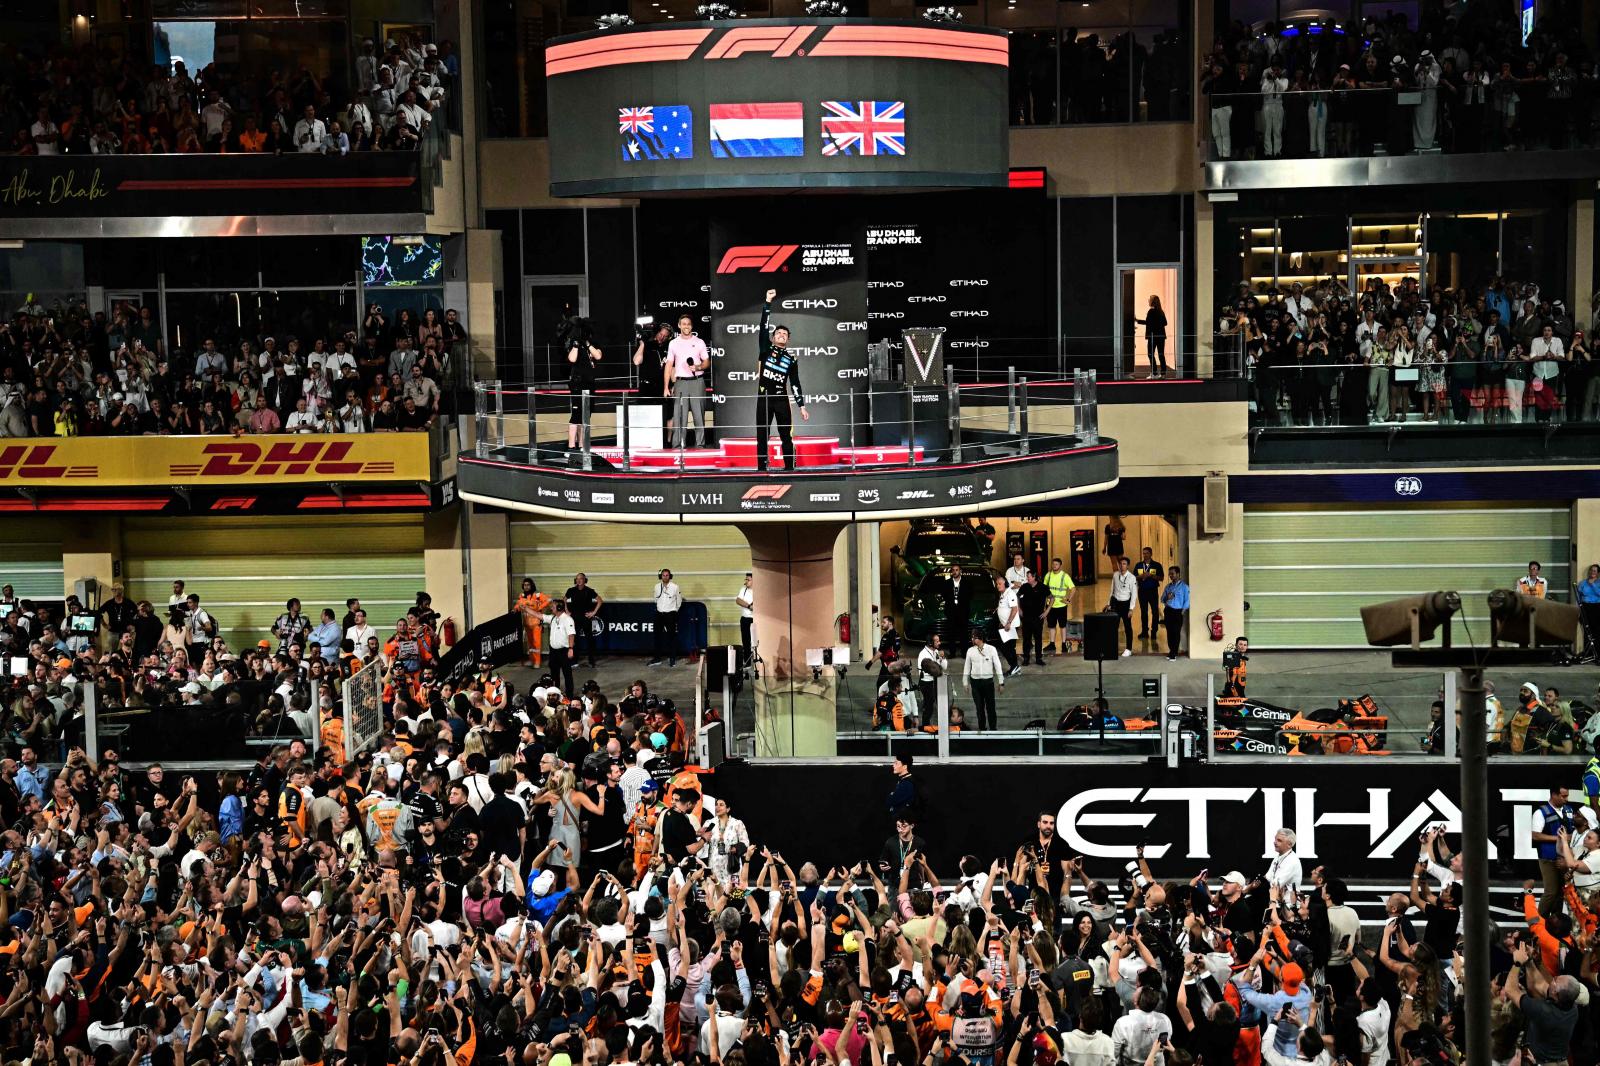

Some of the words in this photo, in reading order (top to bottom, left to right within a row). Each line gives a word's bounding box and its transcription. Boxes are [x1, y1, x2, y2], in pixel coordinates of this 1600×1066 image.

[2, 168, 42, 205] Abu
[49, 168, 110, 204] Dhabi
[884, 229, 915, 237] DHABI
[803, 250, 824, 258] ABU
[824, 249, 850, 257] DHABI
[782, 299, 838, 309] ETIHAD
[774, 446, 784, 460] 1
[877, 453, 883, 461] 3
[202, 442, 368, 476] DHL
[674, 456, 680, 464] 2
[958, 485, 973, 494] MSC
[1396, 478, 1421, 494] FIA
[564, 490, 580, 498] QATAR
[810, 494, 840, 502] PIRELLI
[858, 490, 880, 498] aws
[902, 490, 929, 498] DHL
[628, 496, 664, 504] aramco
[682, 494, 723, 505] LVMH
[1034, 540, 1042, 552] 1
[1076, 540, 1084, 552] 2
[608, 622, 639, 632] PARC
[494, 640, 504, 650] PARC
[454, 650, 474, 680] ETIHAD
[1252, 708, 1291, 720] Gemini
[1246, 740, 1287, 754] Gemni
[1056, 788, 1586, 859] ETIHAD
